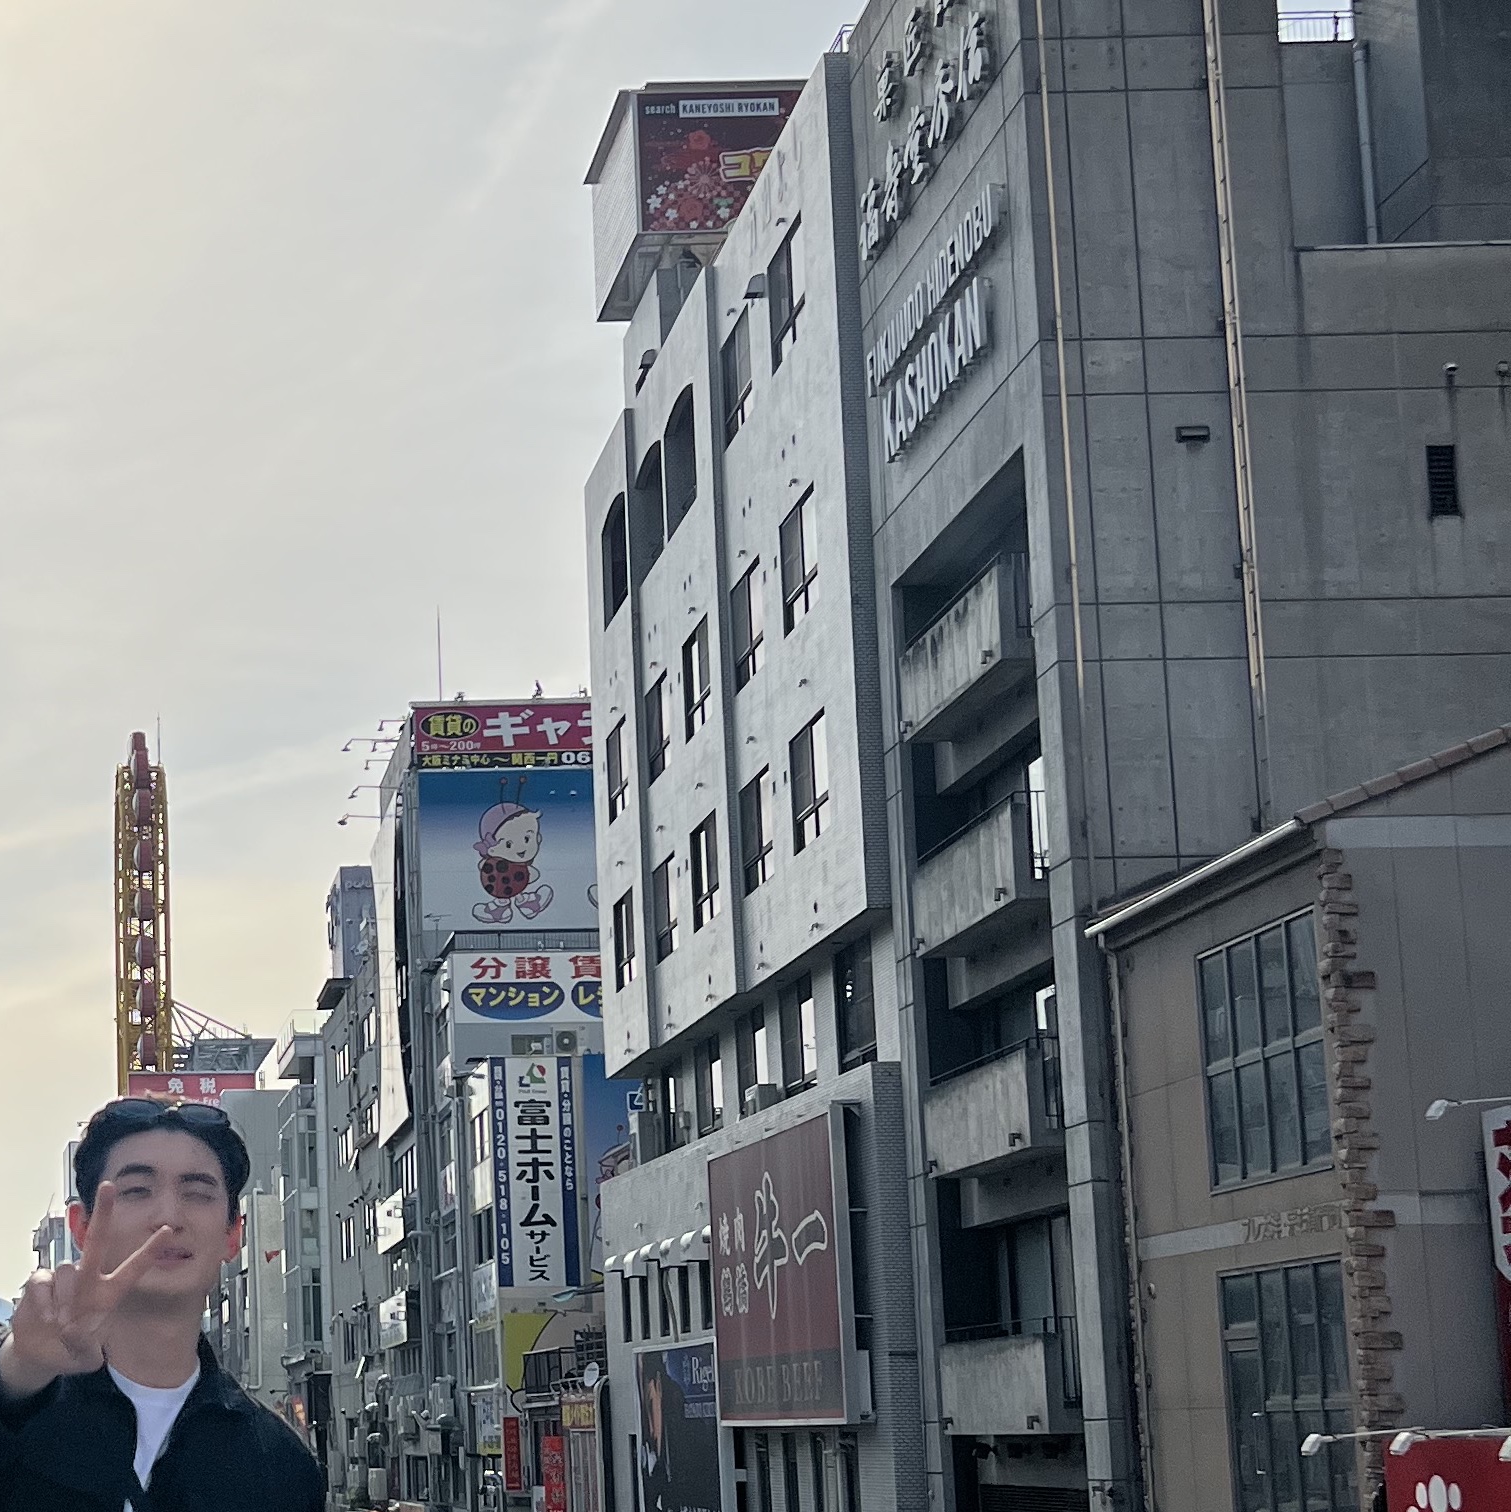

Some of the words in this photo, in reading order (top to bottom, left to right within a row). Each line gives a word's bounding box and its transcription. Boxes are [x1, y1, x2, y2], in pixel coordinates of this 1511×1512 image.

[645, 104, 676, 115] search
[682, 103, 735, 115] KANEYOSHI
[738, 101, 775, 113] RYOKAN
[867, 281, 924, 398] FUKUJUDO
[926, 183, 992, 316] HIDENOBU
[882, 276, 981, 462] KASHOKAN
[428, 714, 477, 737] 賃貸の
[470, 956, 552, 980] 分譲
[468, 986, 559, 1007] マンション
[167, 1077, 217, 1094] 免税
[513, 1098, 558, 1281] 富士ホームサービス
[734, 1365, 776, 1405] KOBE
[780, 1360, 823, 1401] BEEF
